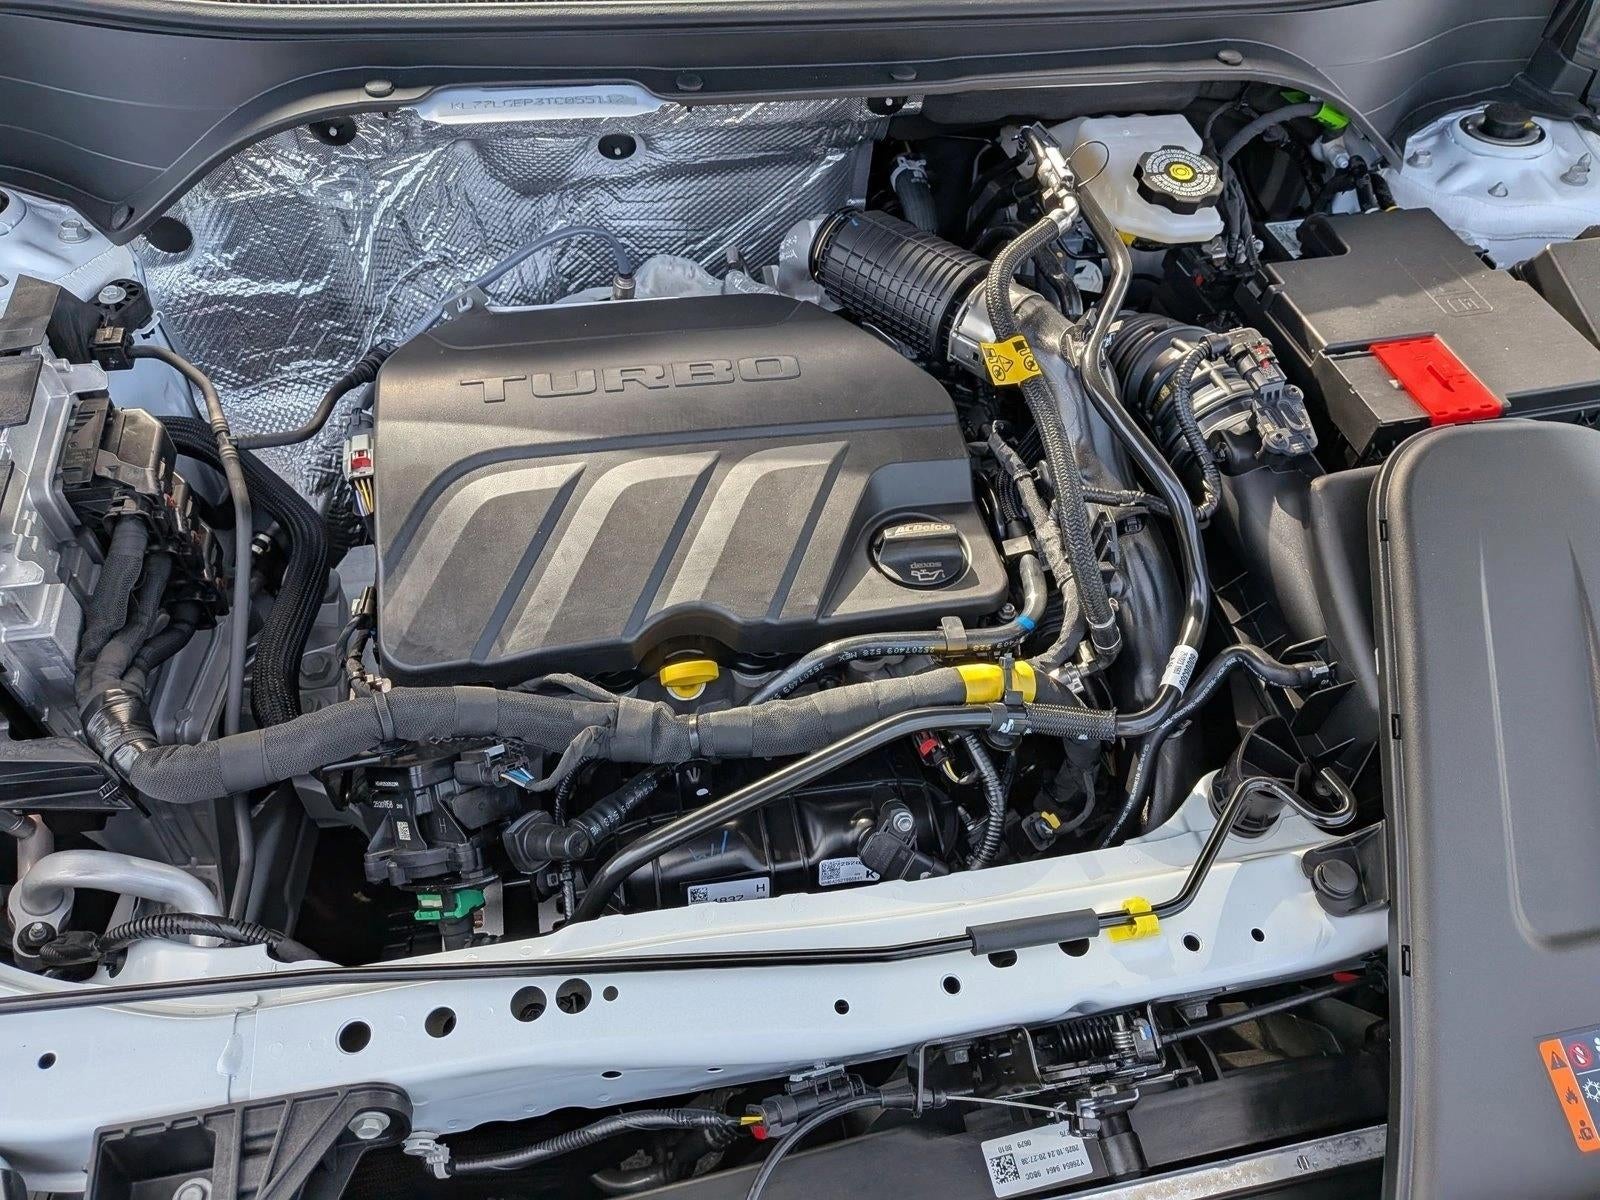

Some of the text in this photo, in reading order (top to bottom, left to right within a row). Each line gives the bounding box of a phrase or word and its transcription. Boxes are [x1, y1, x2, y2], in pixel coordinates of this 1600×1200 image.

[460, 354, 801, 403] TURBO
[910, 561, 942, 569] dexos
[756, 883, 765, 892] H
